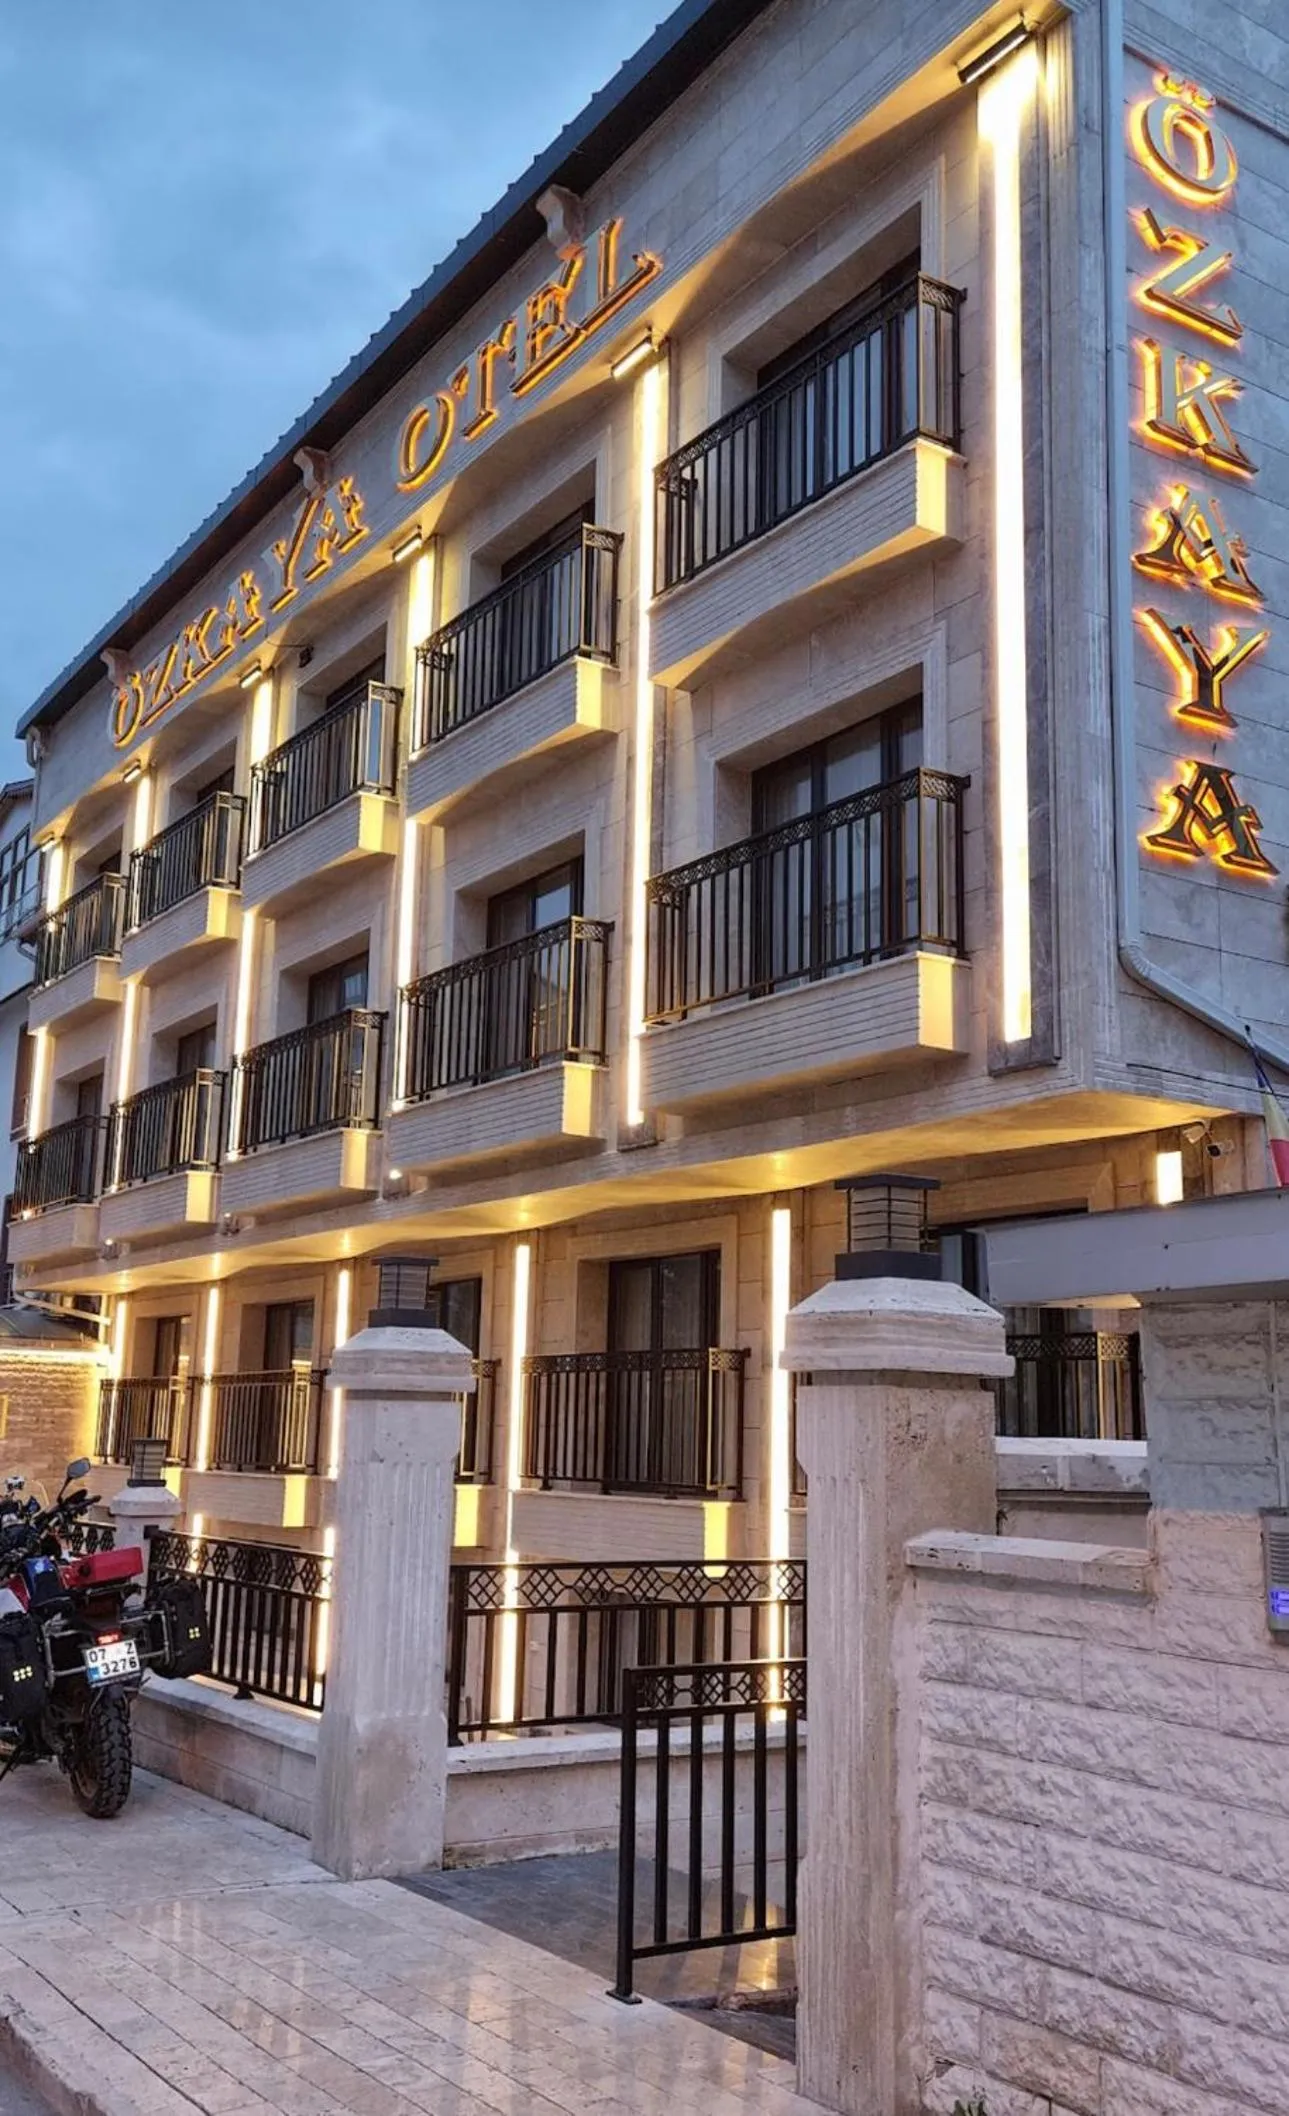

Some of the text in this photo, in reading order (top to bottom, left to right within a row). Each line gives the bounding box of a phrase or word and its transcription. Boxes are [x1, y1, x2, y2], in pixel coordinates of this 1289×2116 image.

[107, 216, 664, 749] ÖZKAYA OTEL
[1127, 70, 1281, 877] ÖZKAYA
[89, 1648, 105, 1662] 07
[101, 1656, 137, 1675] 3276
